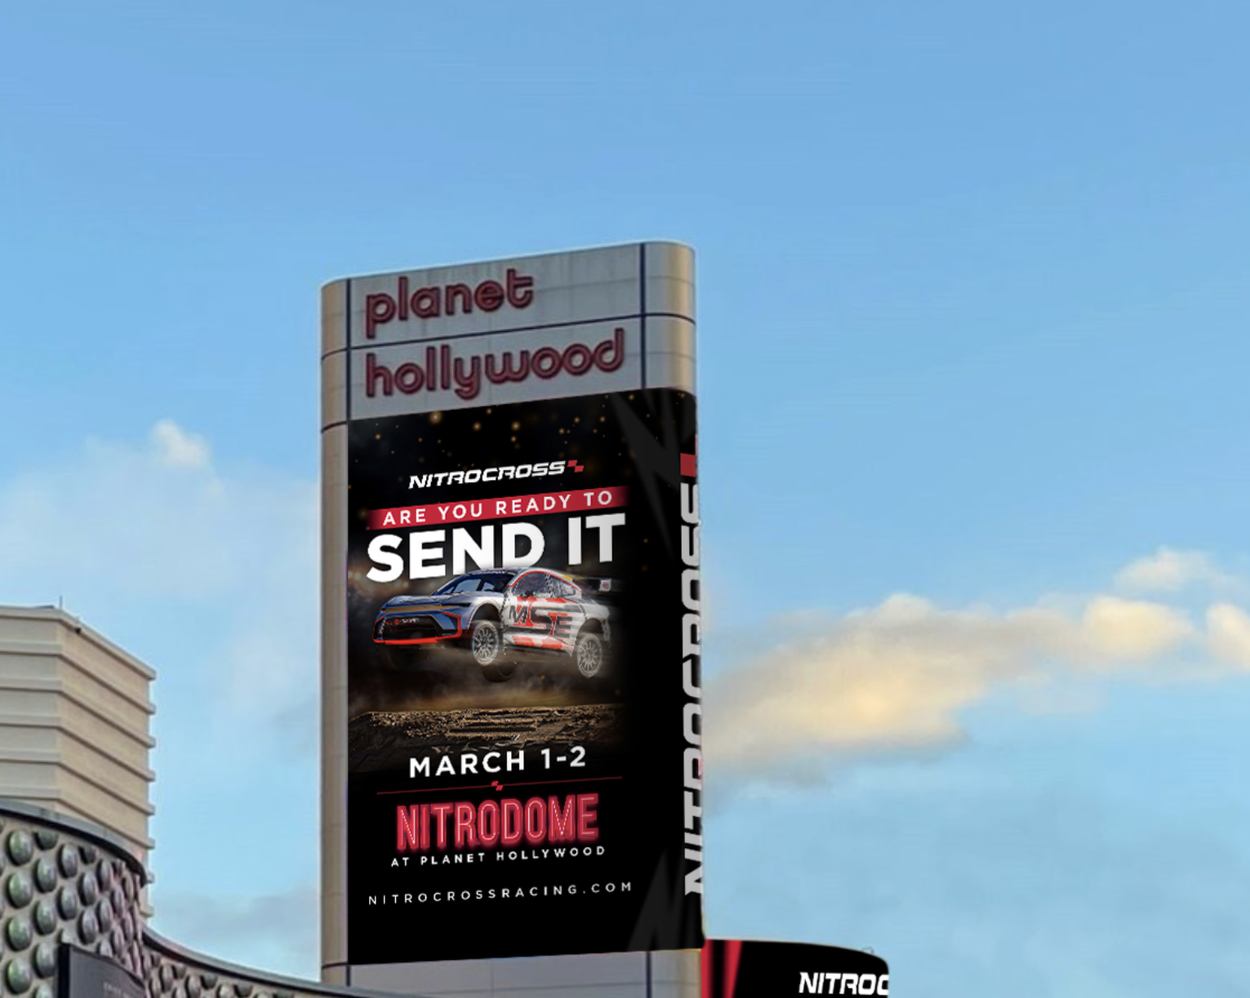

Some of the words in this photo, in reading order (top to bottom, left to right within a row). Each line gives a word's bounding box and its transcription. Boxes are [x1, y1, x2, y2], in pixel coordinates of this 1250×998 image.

[365, 268, 534, 339] planet
[365, 327, 624, 400] hollywood
[408, 460, 566, 489] NITROCROSS
[383, 510, 426, 526] ARE
[437, 503, 483, 521] YOU
[495, 494, 572, 514] READY
[583, 490, 612, 506] TO
[366, 521, 546, 583] SEND
[567, 513, 626, 565] IT
[409, 750, 525, 778] MARCH
[541, 746, 586, 769] 1-2
[396, 793, 599, 851] NITRODOME
[390, 857, 410, 868] AT
[420, 852, 486, 866] PLANET
[496, 846, 606, 862] HOLLYWOOD
[368, 881, 633, 906] NITROCROSSRACING.COM
